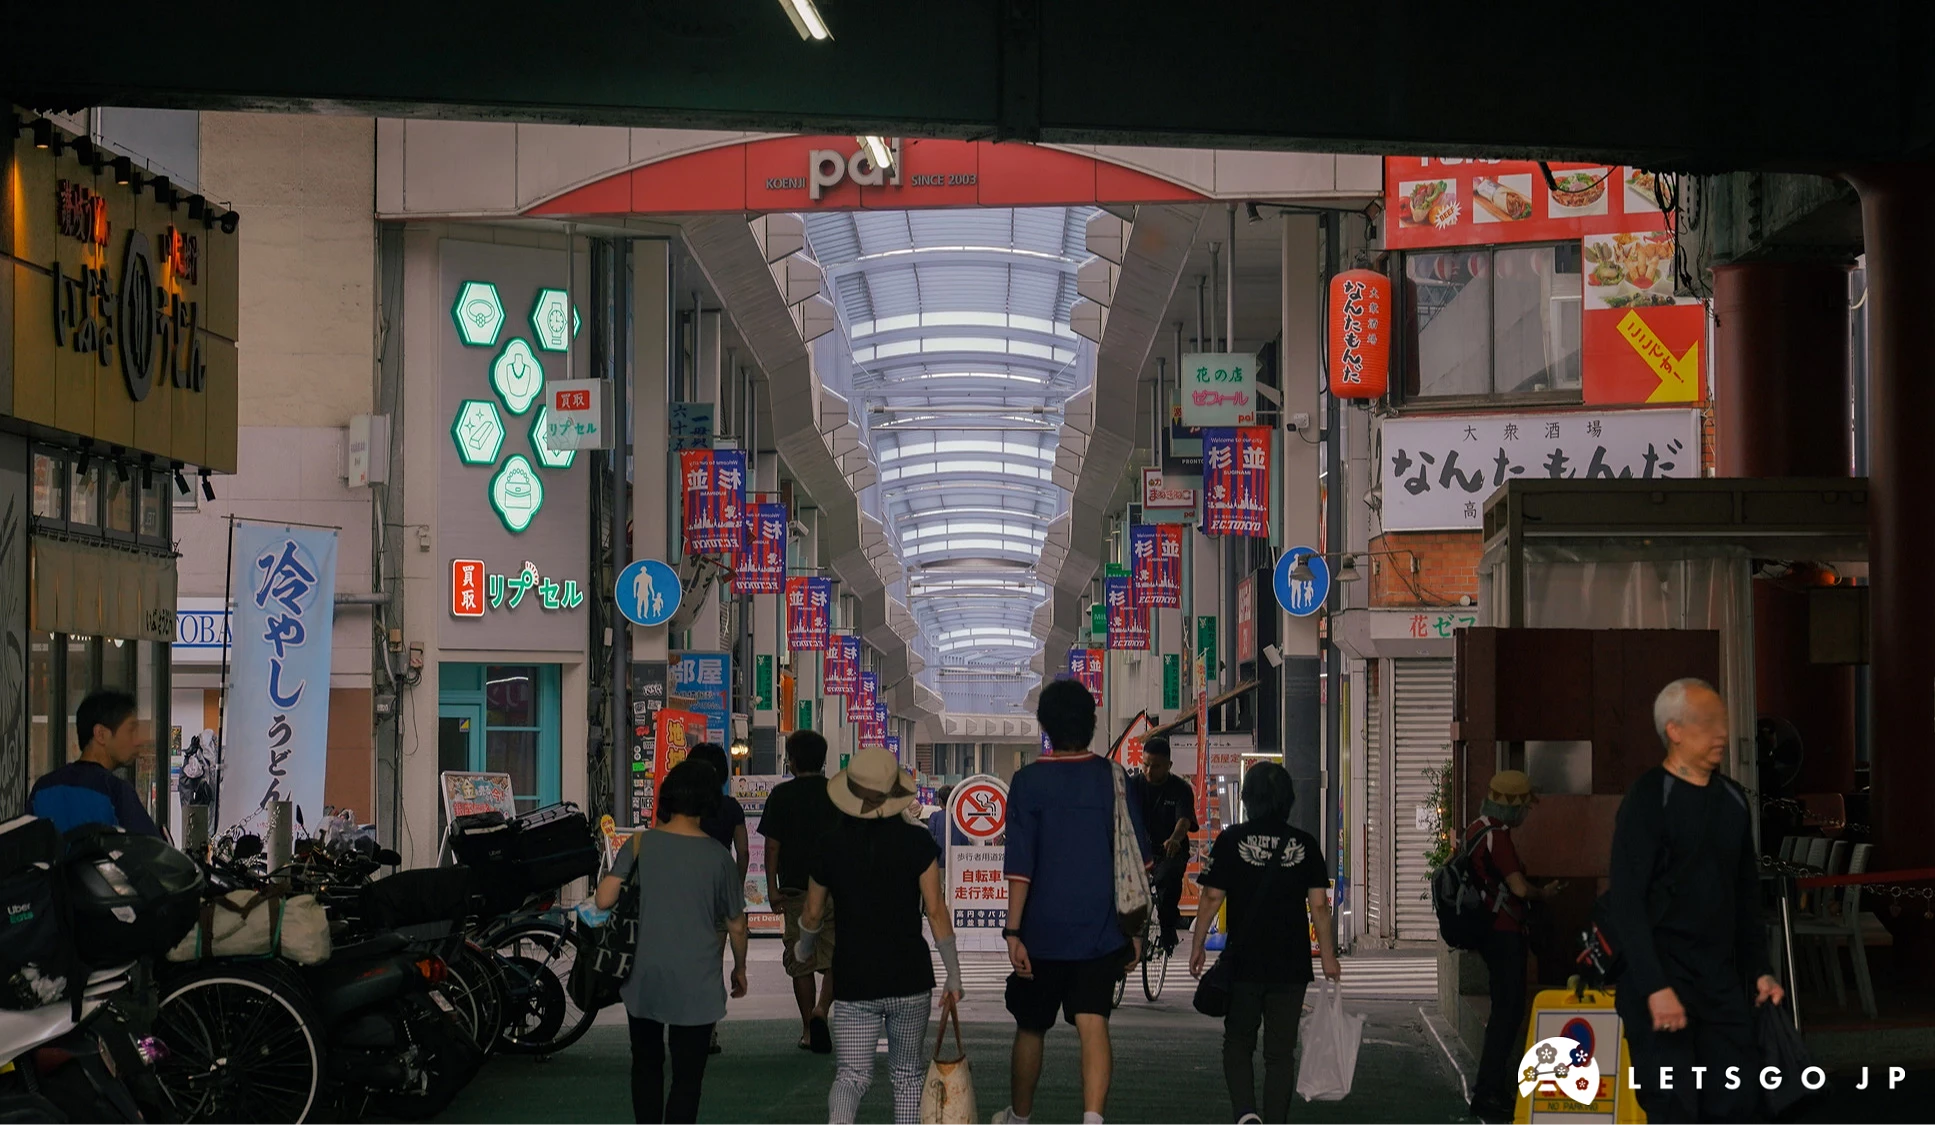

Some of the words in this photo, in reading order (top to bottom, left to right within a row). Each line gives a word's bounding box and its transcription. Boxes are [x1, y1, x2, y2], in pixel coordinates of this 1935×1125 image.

[766, 177, 806, 189] KOENJI
[911, 174, 944, 186] SINCE
[948, 173, 977, 185] 2003
[1439, 206, 1456, 221] BEEF
[1342, 280, 1365, 383] なんたもんだ
[1196, 367, 1243, 383] 花の店
[560, 393, 585, 408] 買取
[1191, 389, 1249, 406] ゼフィール
[1463, 421, 1603, 442] 大衆酒場
[1208, 446, 1265, 470] 杉並
[461, 564, 476, 610] 買取
[489, 567, 583, 609] リプセル
[176, 615, 232, 643] OBA
[962, 870, 1002, 883] 自転車
[955, 887, 1008, 900] 走行禁止
[956, 910, 1006, 918] 高円寺パル
[1547, 1102, 1559, 1110] NO
